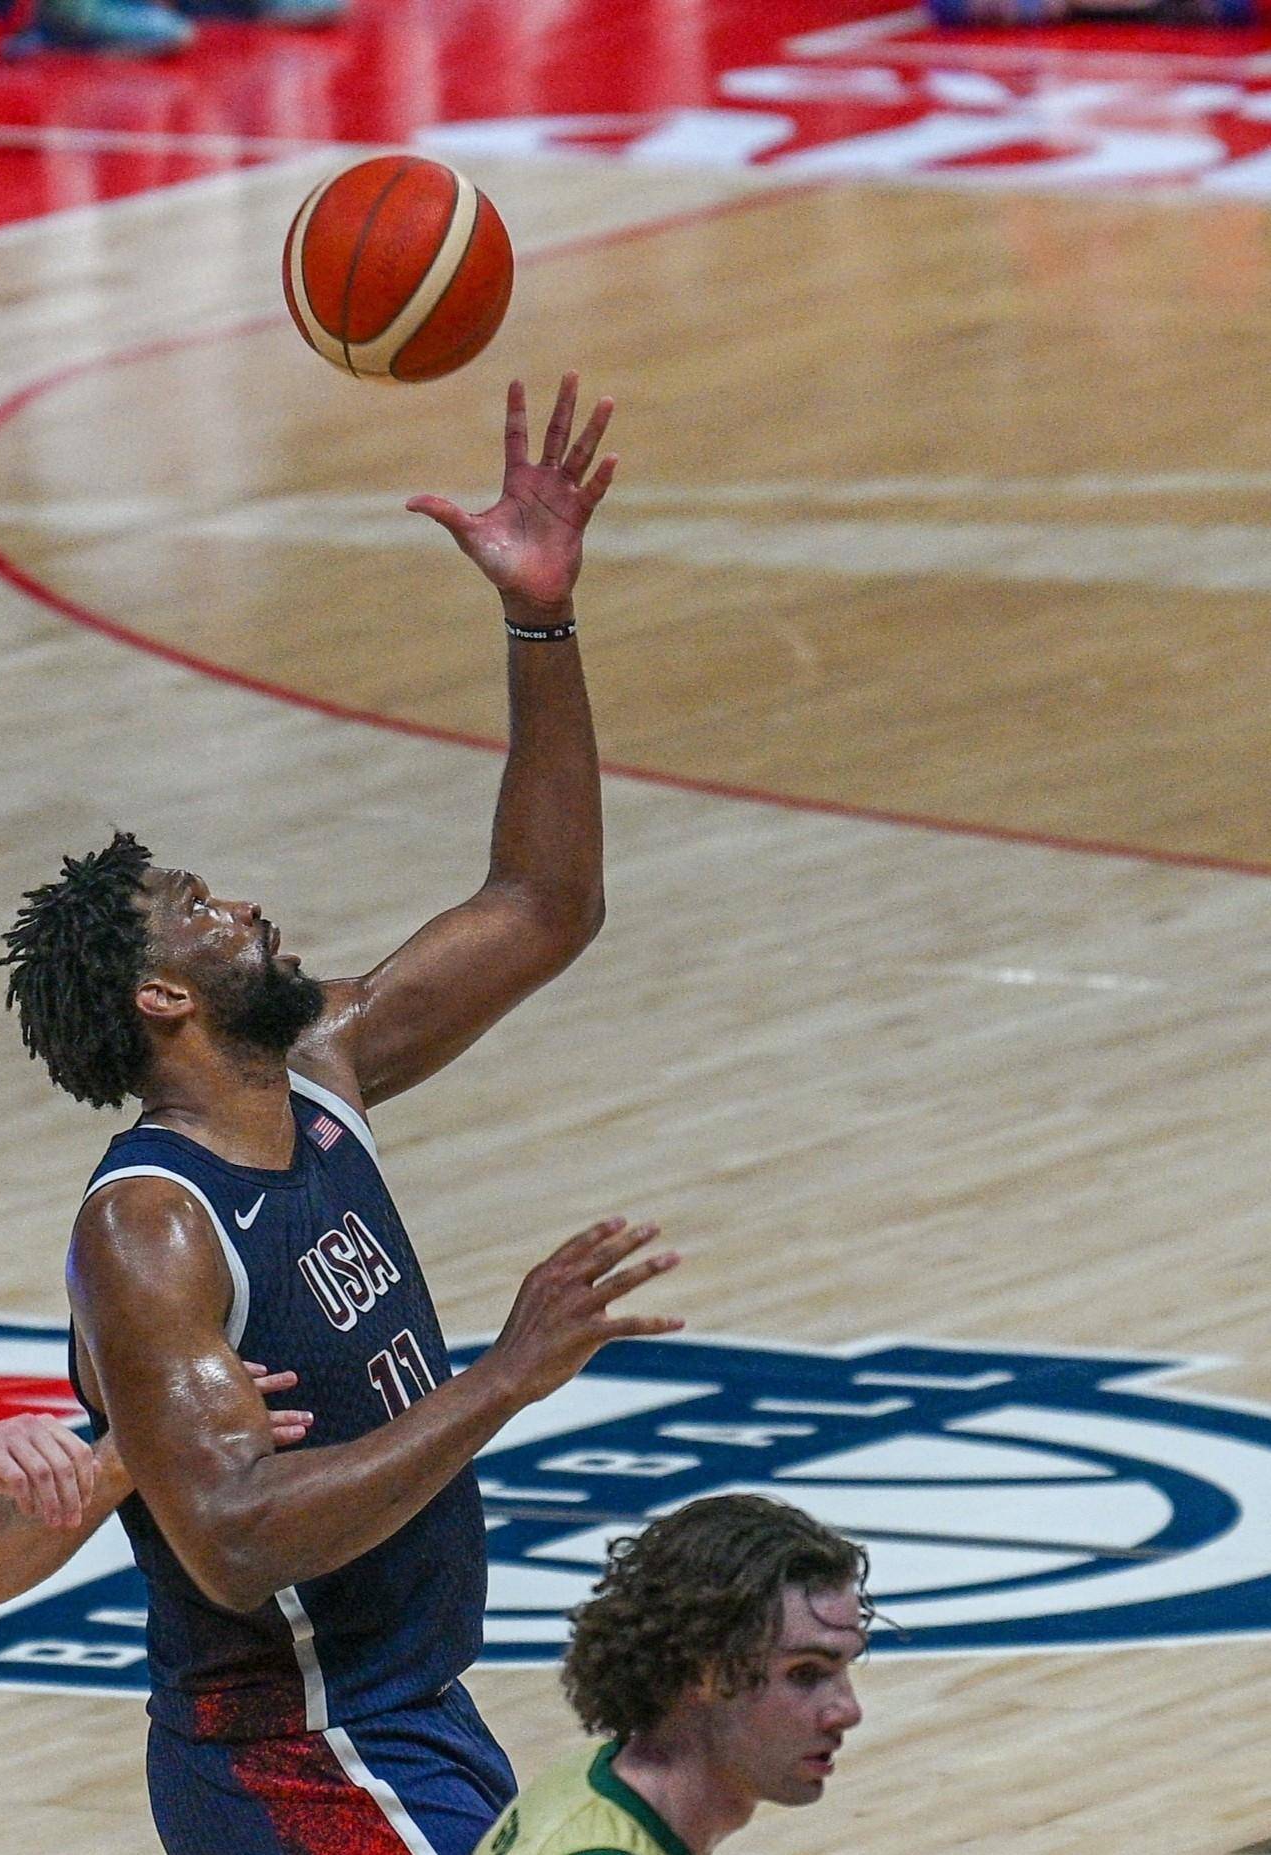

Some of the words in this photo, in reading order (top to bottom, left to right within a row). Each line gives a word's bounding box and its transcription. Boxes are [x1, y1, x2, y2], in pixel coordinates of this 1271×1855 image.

[516, 628, 547, 639] Process
[298, 1211, 401, 1332] USA
[367, 1328, 437, 1421] 11
